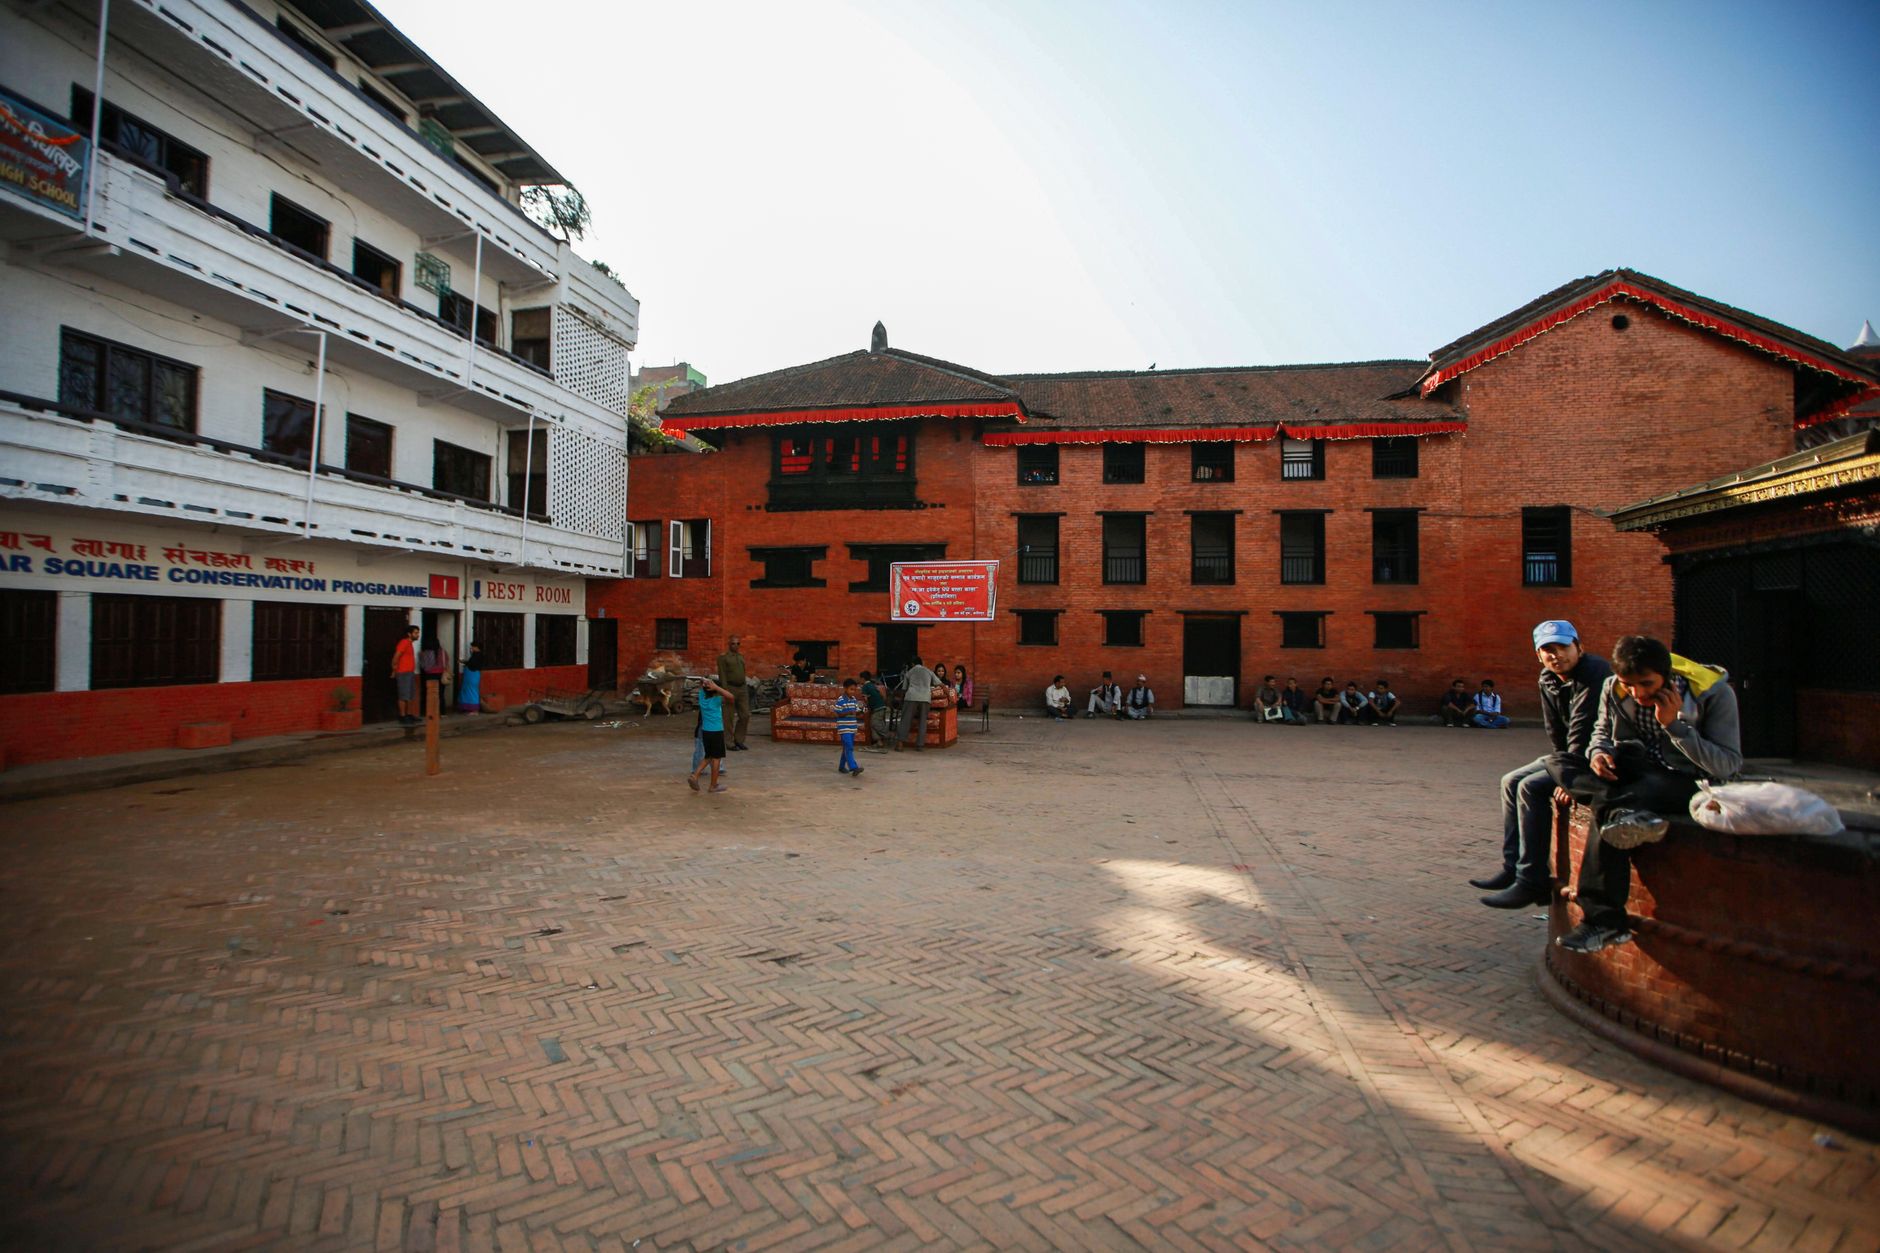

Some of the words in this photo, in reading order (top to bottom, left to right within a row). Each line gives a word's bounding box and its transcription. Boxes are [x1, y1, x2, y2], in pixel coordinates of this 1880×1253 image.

[29, 174, 77, 208] SCHOOL
[43, 557, 160, 581] SQUARE
[167, 568, 327, 592] CONSERVATION
[332, 580, 428, 598] PROGRAMME
[486, 581, 525, 600] REST
[535, 586, 571, 604] ROOM
